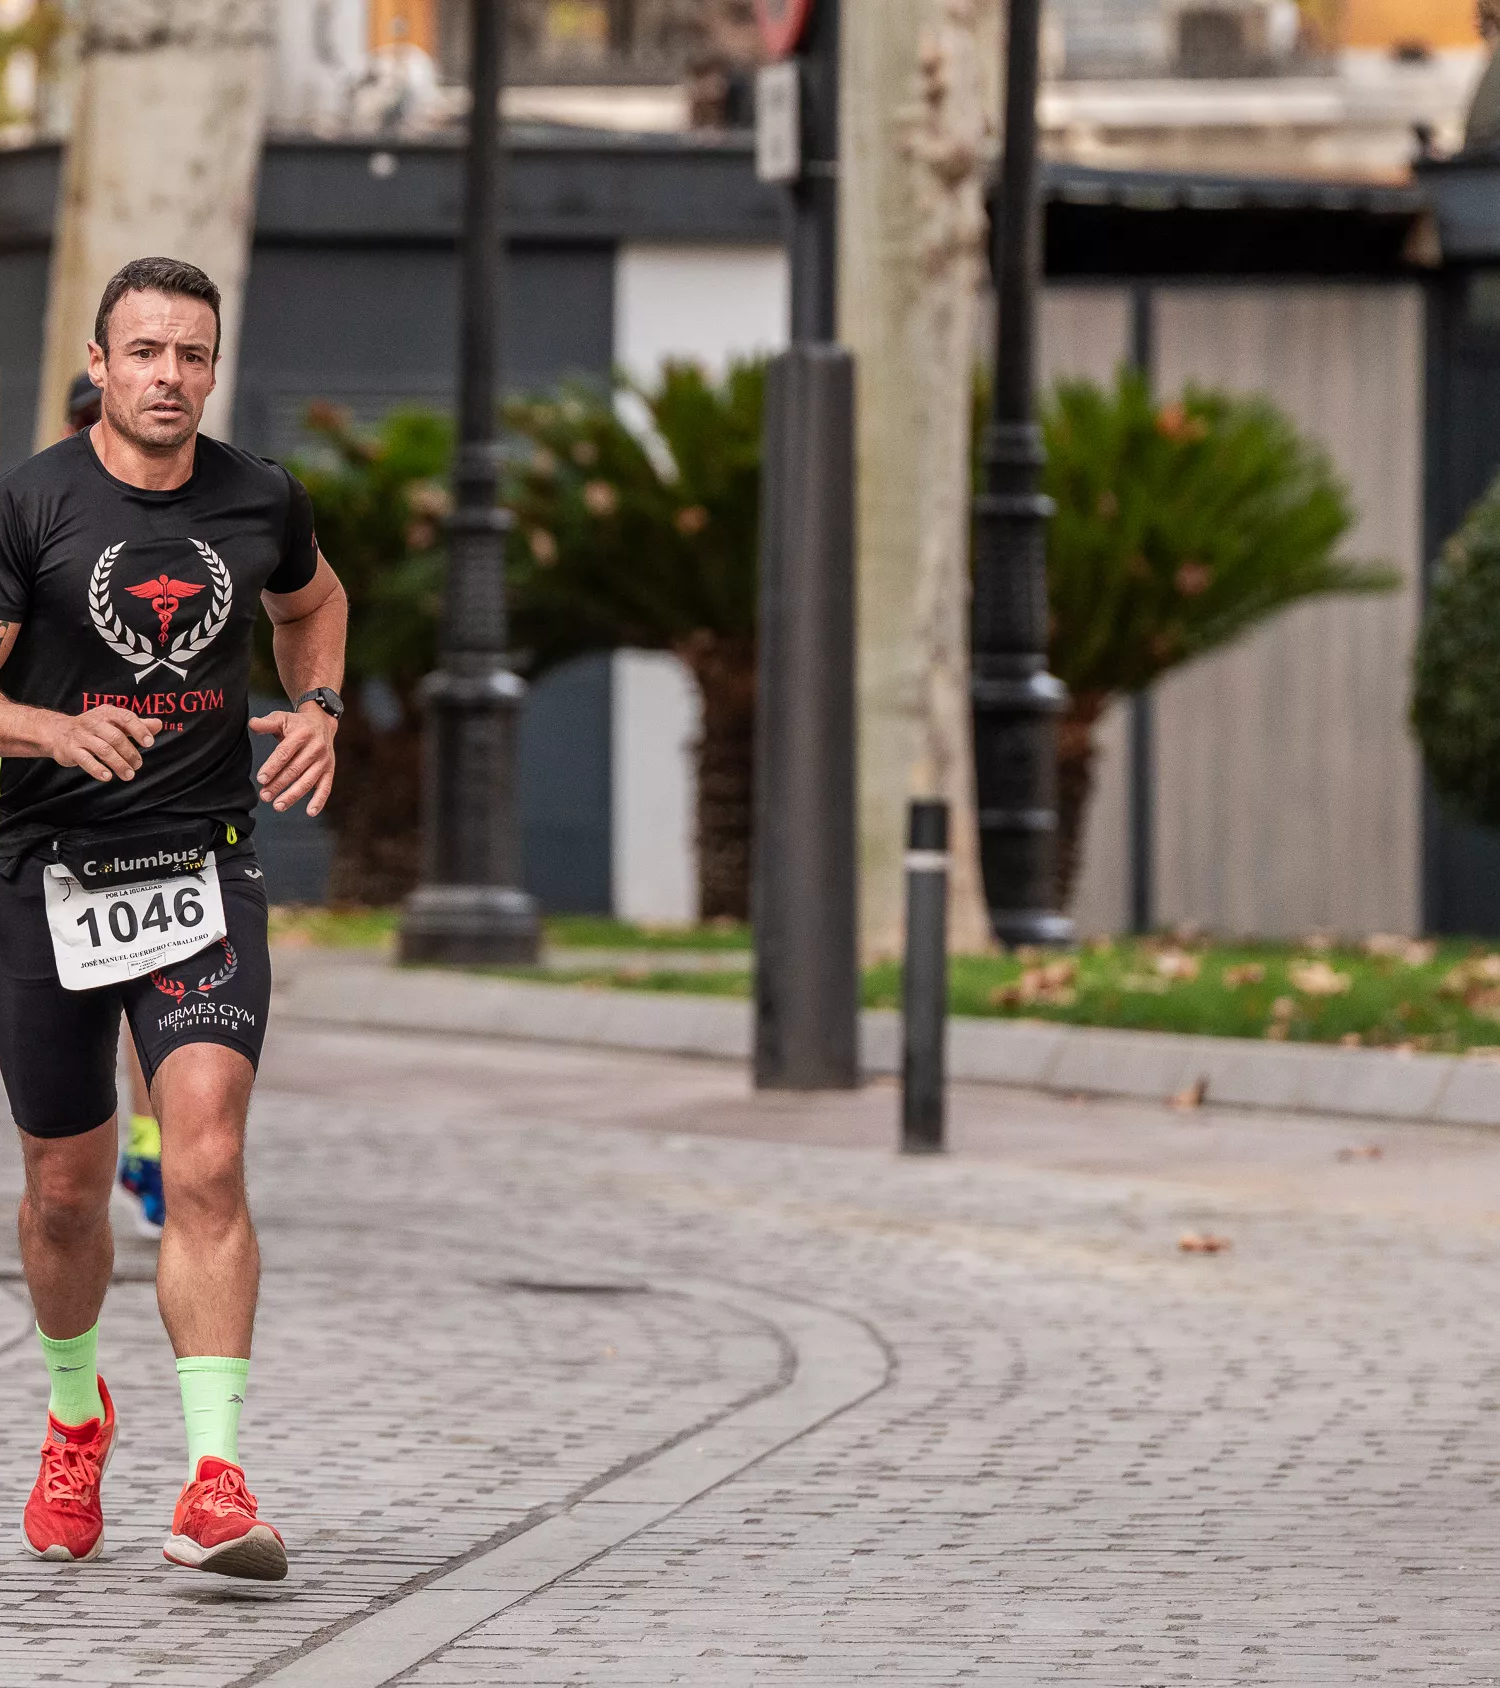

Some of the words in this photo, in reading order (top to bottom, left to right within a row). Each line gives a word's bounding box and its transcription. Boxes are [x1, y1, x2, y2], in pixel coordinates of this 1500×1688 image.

[82, 691, 176, 715] HERMES
[180, 688, 224, 713] GYM
[83, 847, 200, 877] Columbus
[183, 858, 205, 870] Trai
[105, 892, 119, 900] POR
[129, 884, 162, 895] IGUALDAD
[76, 887, 205, 948] 1046
[80, 959, 98, 969] JOSÉ
[98, 953, 129, 966] MANUEL
[129, 944, 167, 959] GUERRERO
[167, 933, 209, 950] CABALLERO
[158, 1002, 216, 1031] HERMES
[219, 1003, 255, 1027] GYM
[172, 1014, 239, 1032] Training
